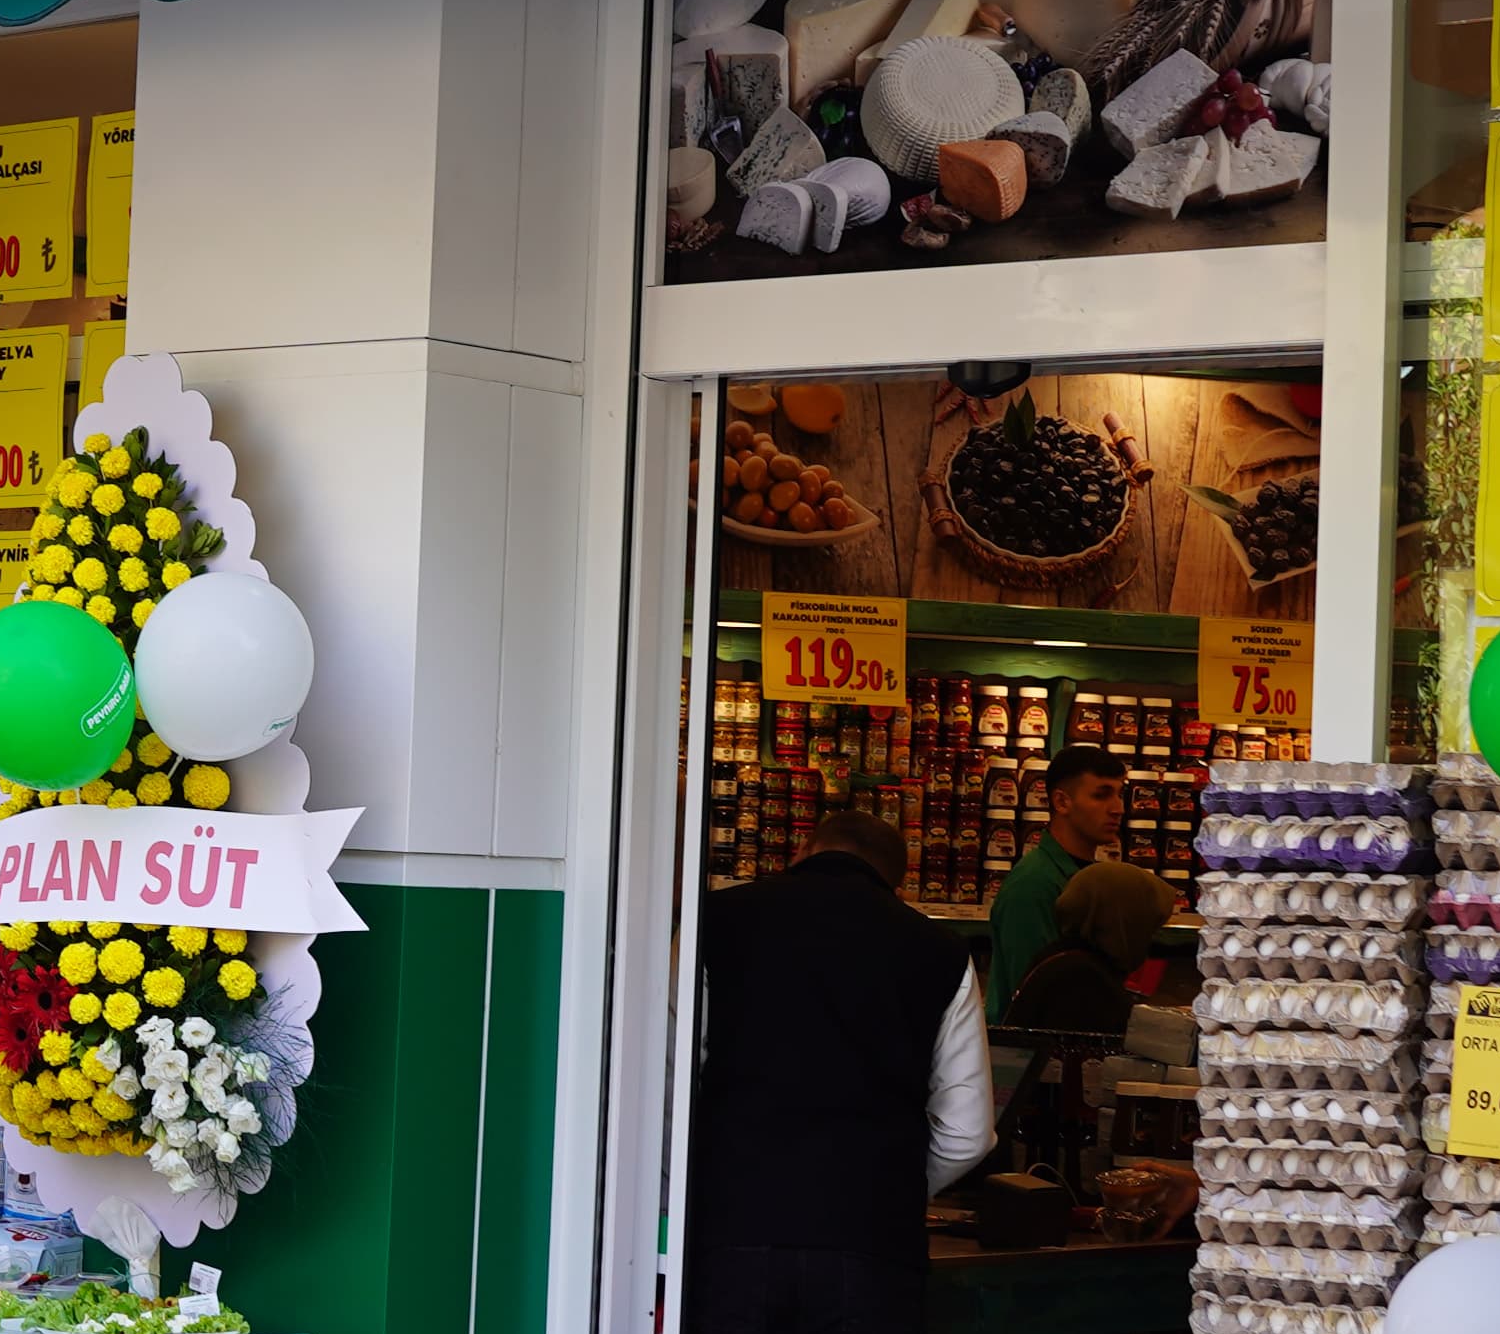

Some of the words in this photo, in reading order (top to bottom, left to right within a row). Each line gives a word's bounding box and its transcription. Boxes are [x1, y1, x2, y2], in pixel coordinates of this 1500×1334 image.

[772, 612, 820, 623] KAKAOLU
[821, 615, 854, 625] FINDIK
[855, 617, 898, 628] KREMASI
[790, 601, 851, 614] FİSKOBİRLİK
[852, 605, 879, 615] NUGA
[784, 635, 884, 692] 119.50
[1231, 665, 1297, 716] 75.00
[140, 825, 259, 910] SÜT
[1461, 1035, 1499, 1052] ORTA
